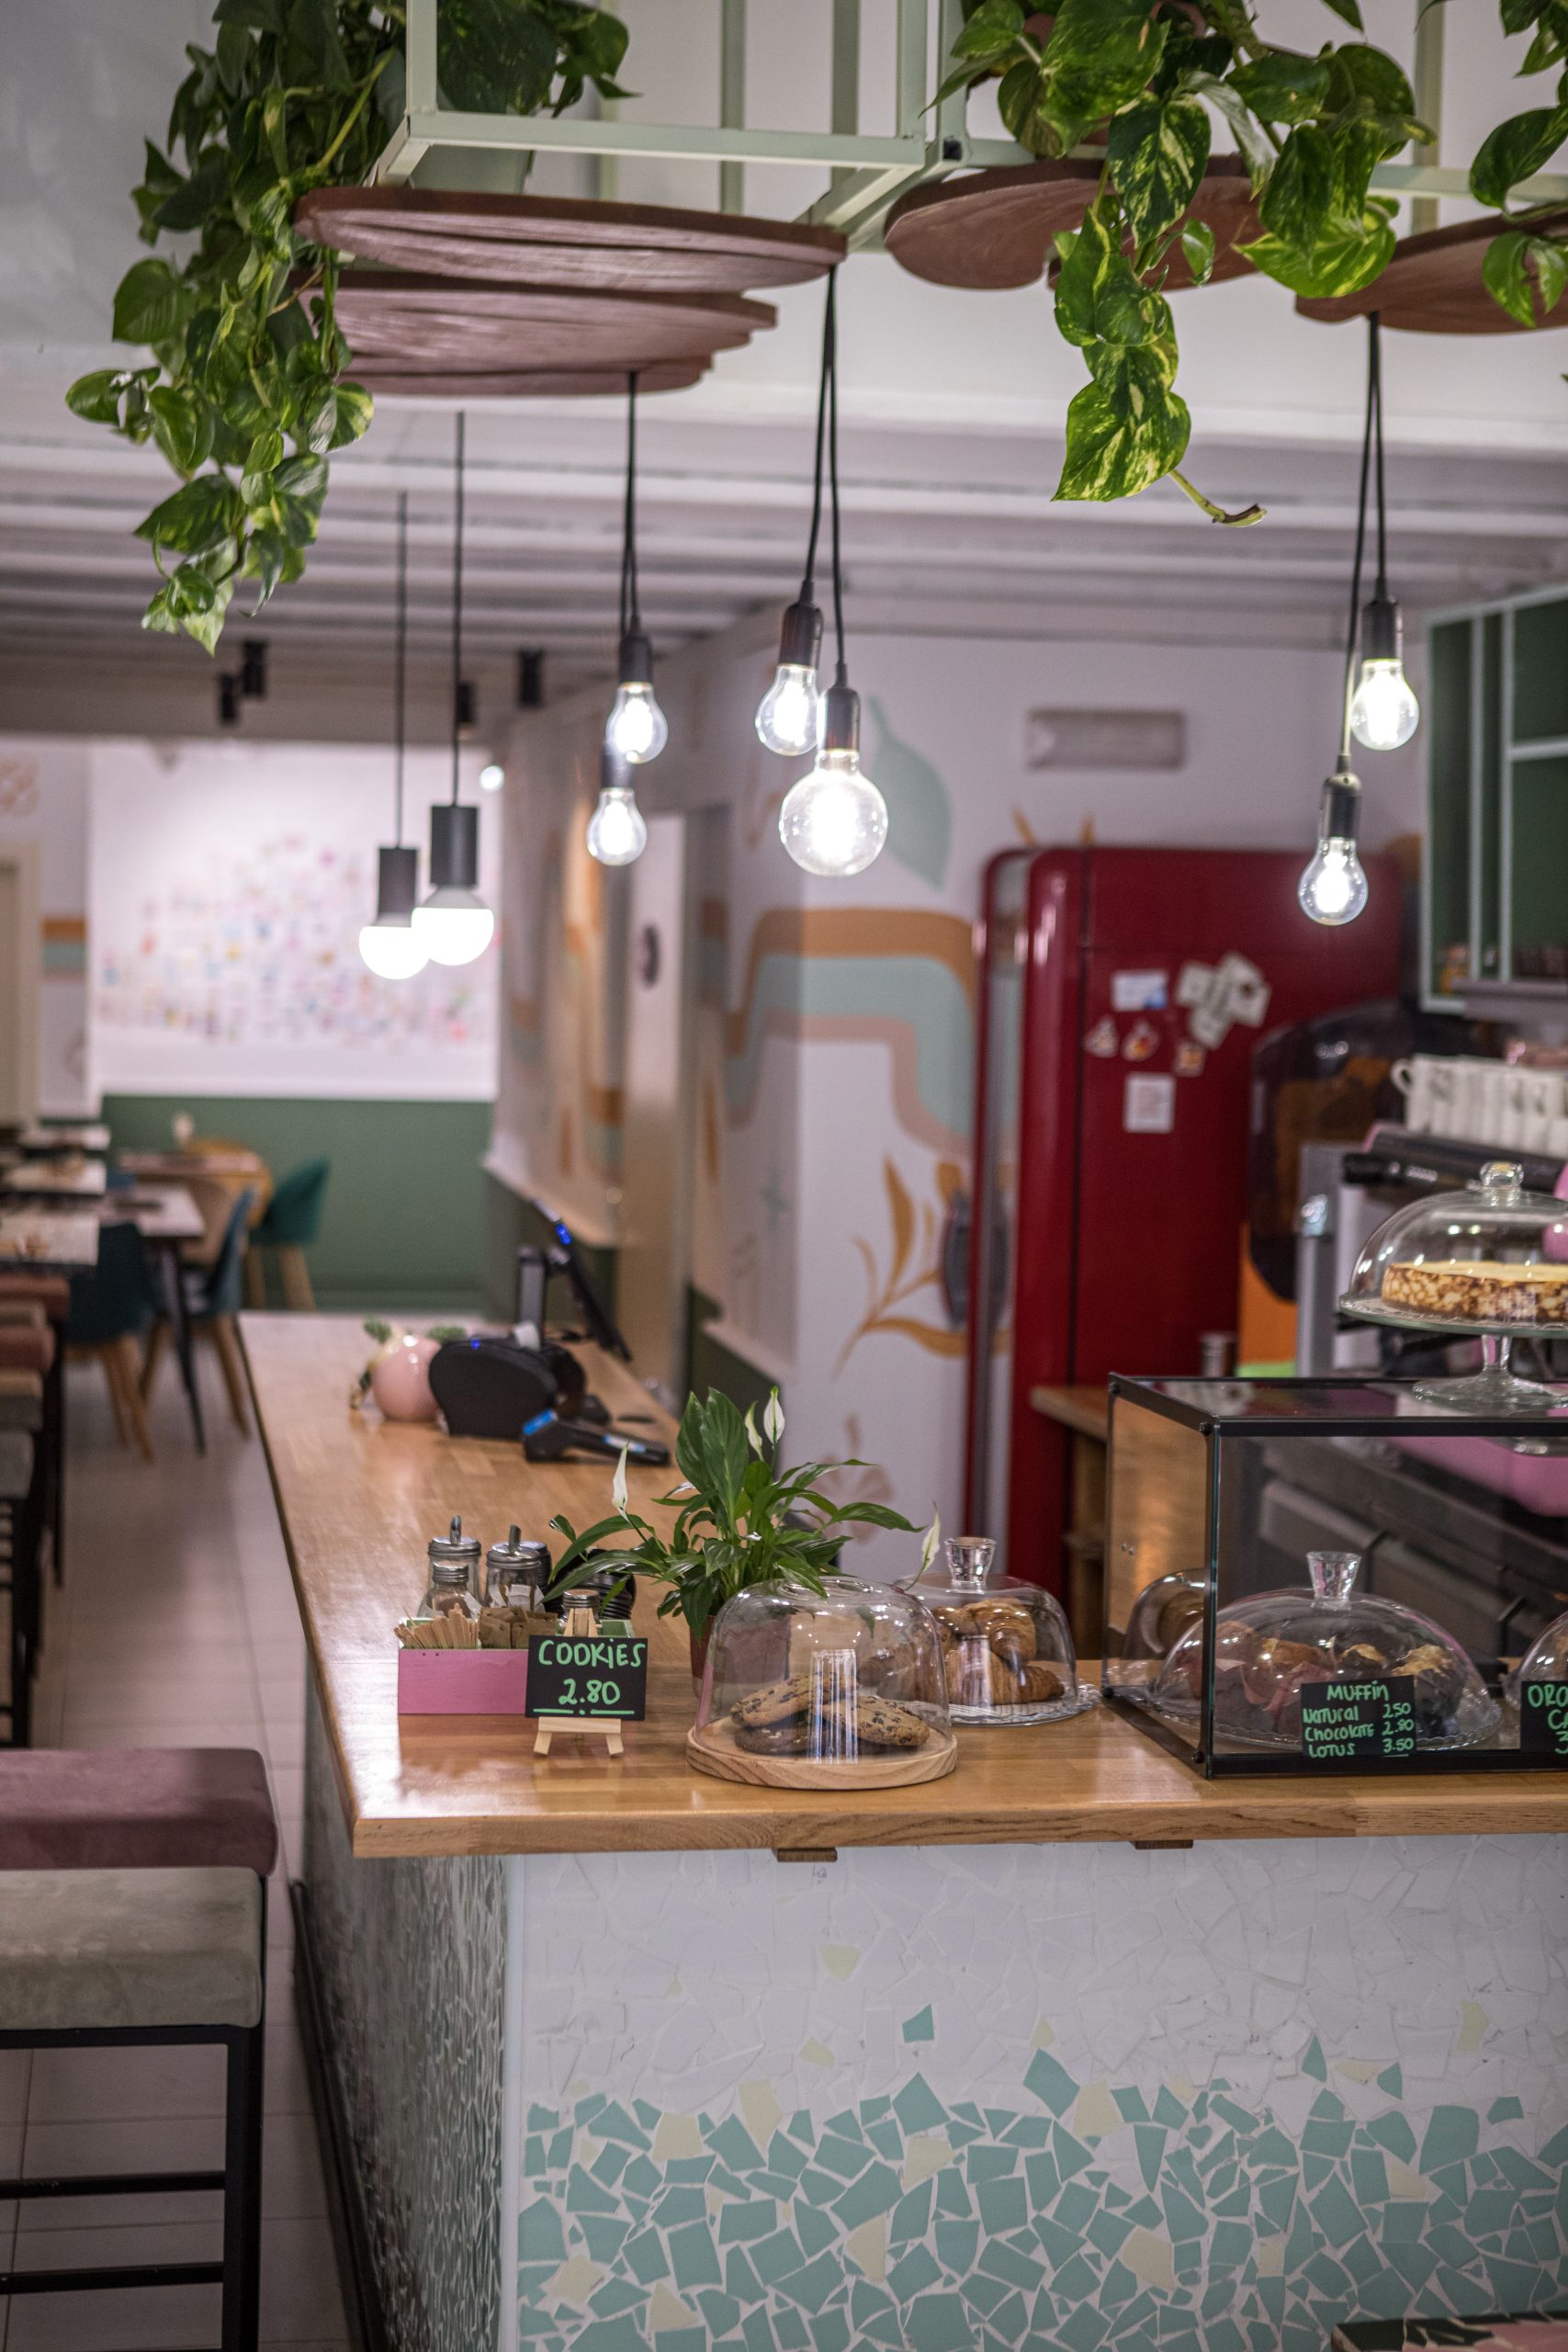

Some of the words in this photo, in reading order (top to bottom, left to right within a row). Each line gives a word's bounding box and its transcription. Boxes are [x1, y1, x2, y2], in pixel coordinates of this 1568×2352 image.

[558, 1678, 621, 1705] 2.80
[1382, 1718, 1415, 1736] 2.80
[1308, 1742, 1356, 1758] LOTUS
[1382, 1737, 1415, 1754] 3.50
